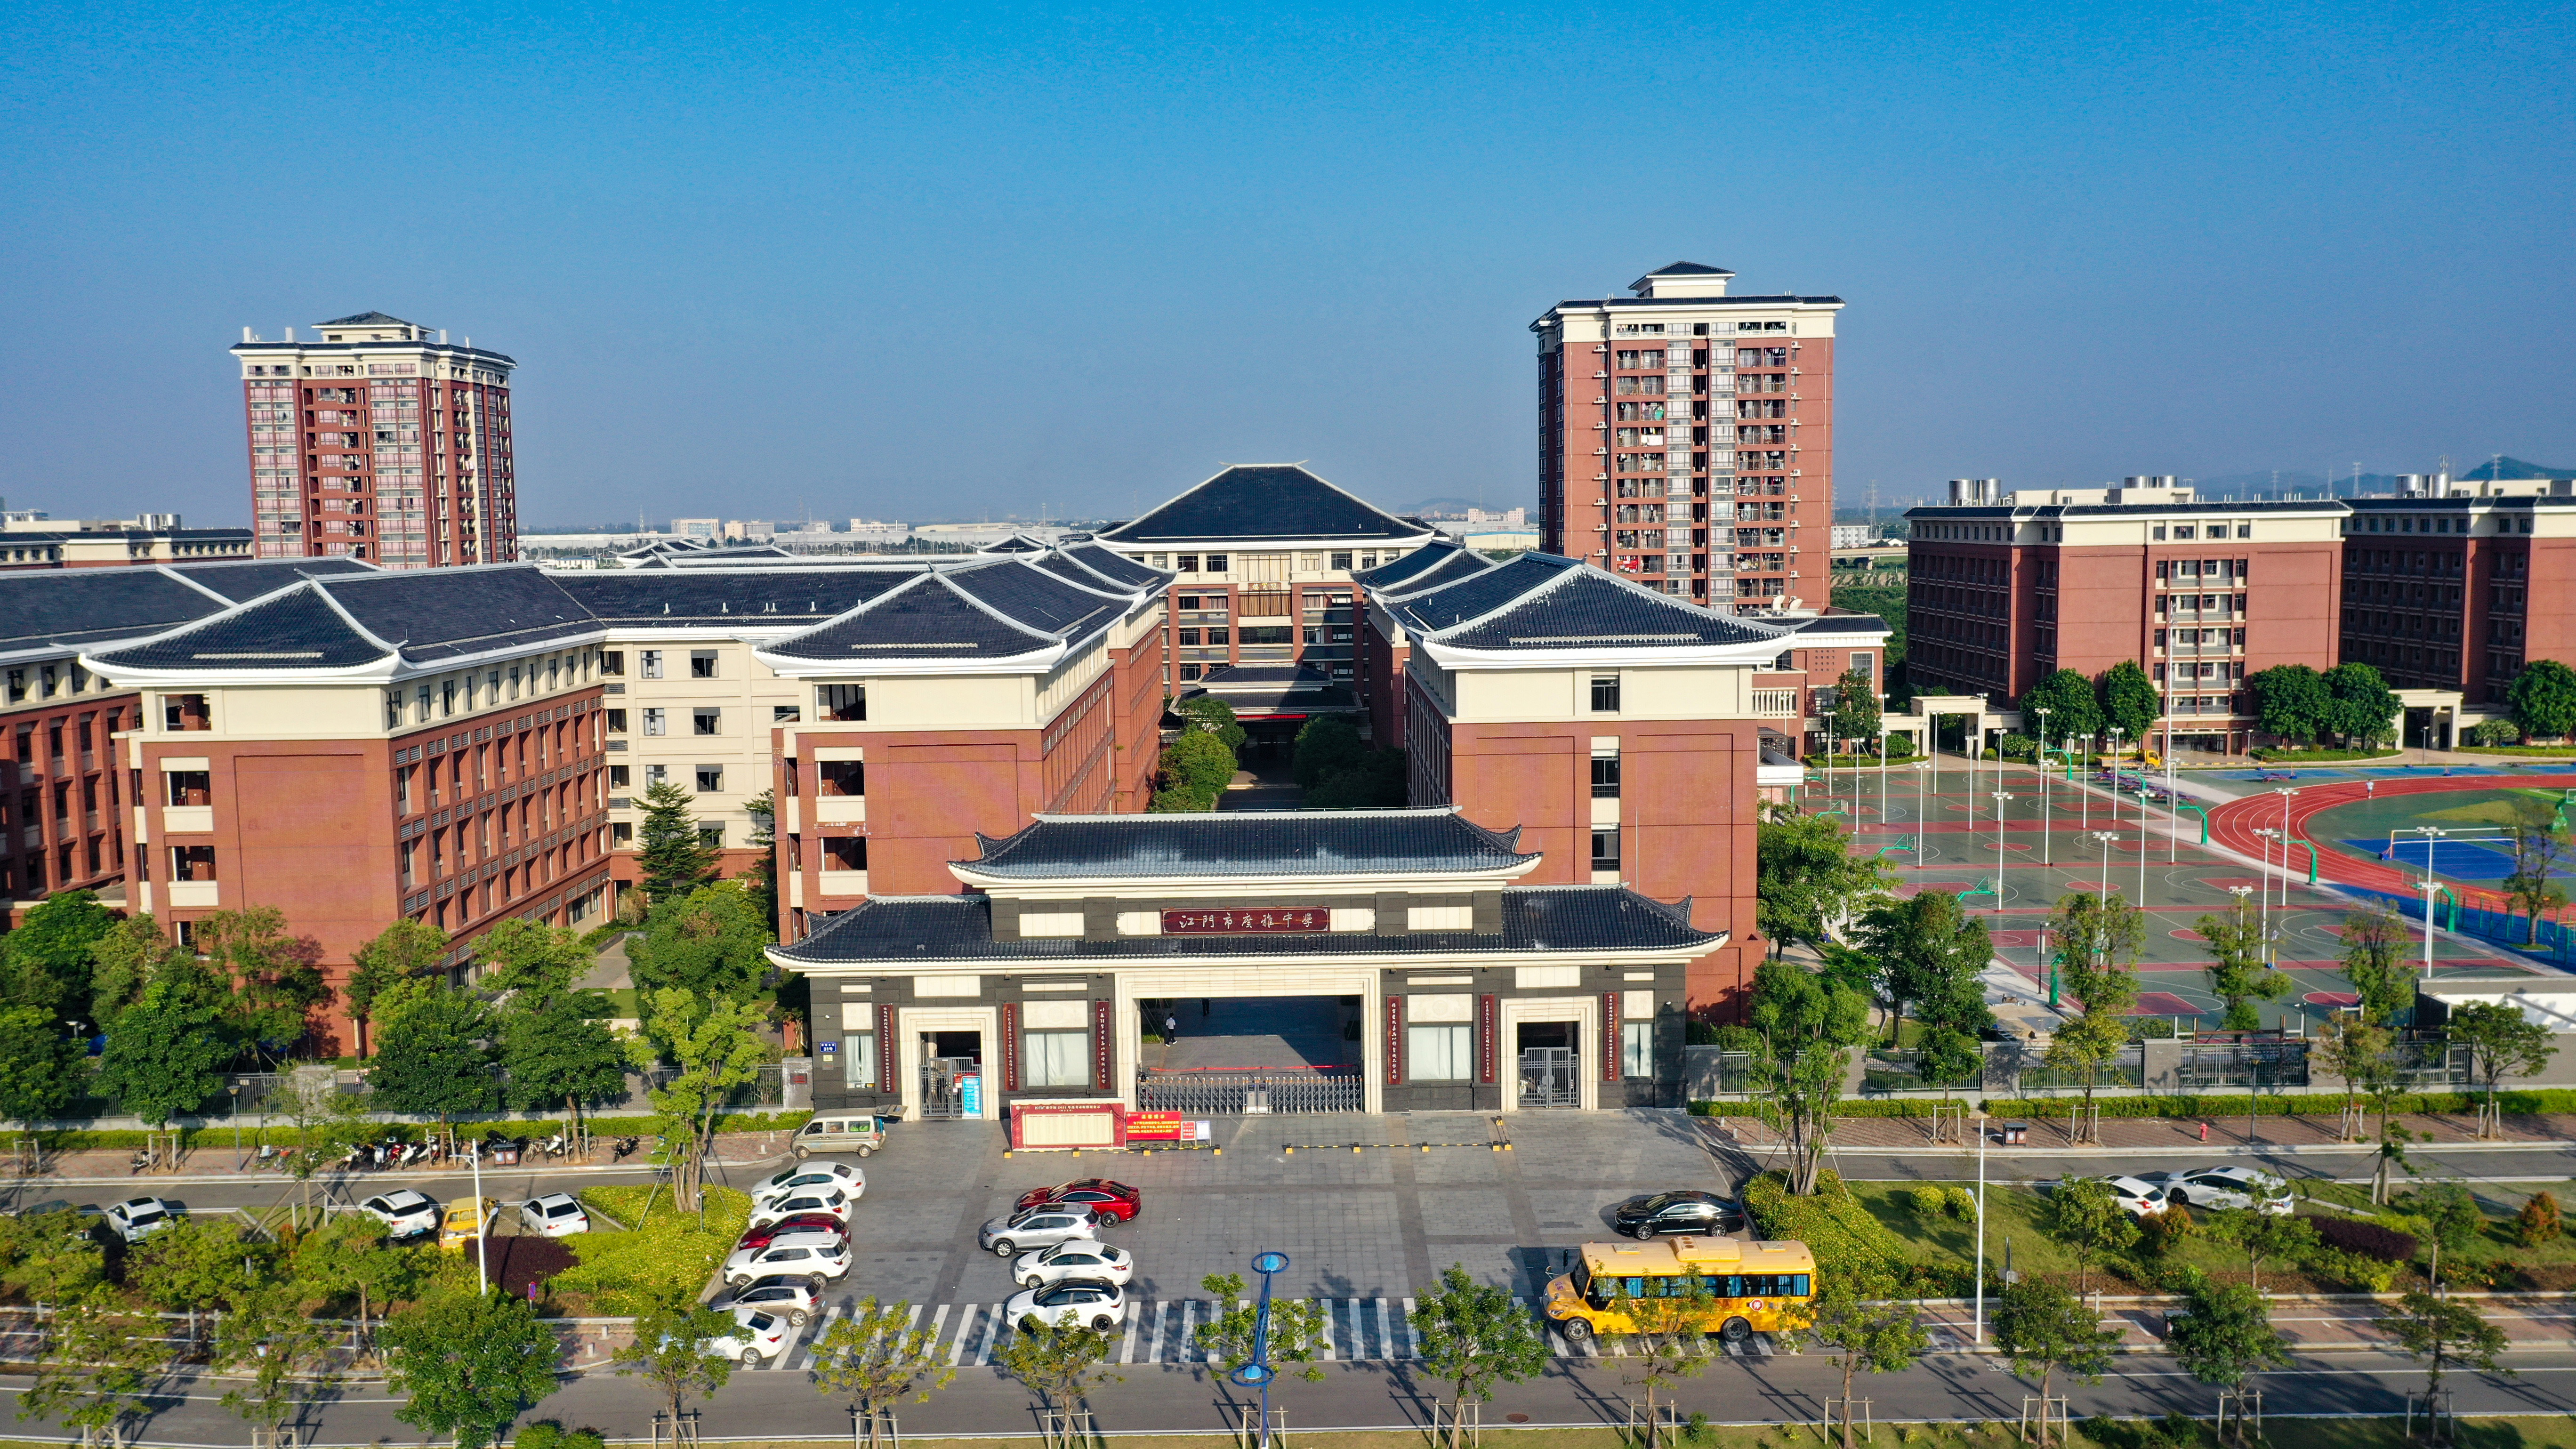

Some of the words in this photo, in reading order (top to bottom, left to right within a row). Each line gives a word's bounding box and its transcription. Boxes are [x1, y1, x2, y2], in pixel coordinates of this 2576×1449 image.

[1179, 912, 1313, 929] 江門市廣雅中學
